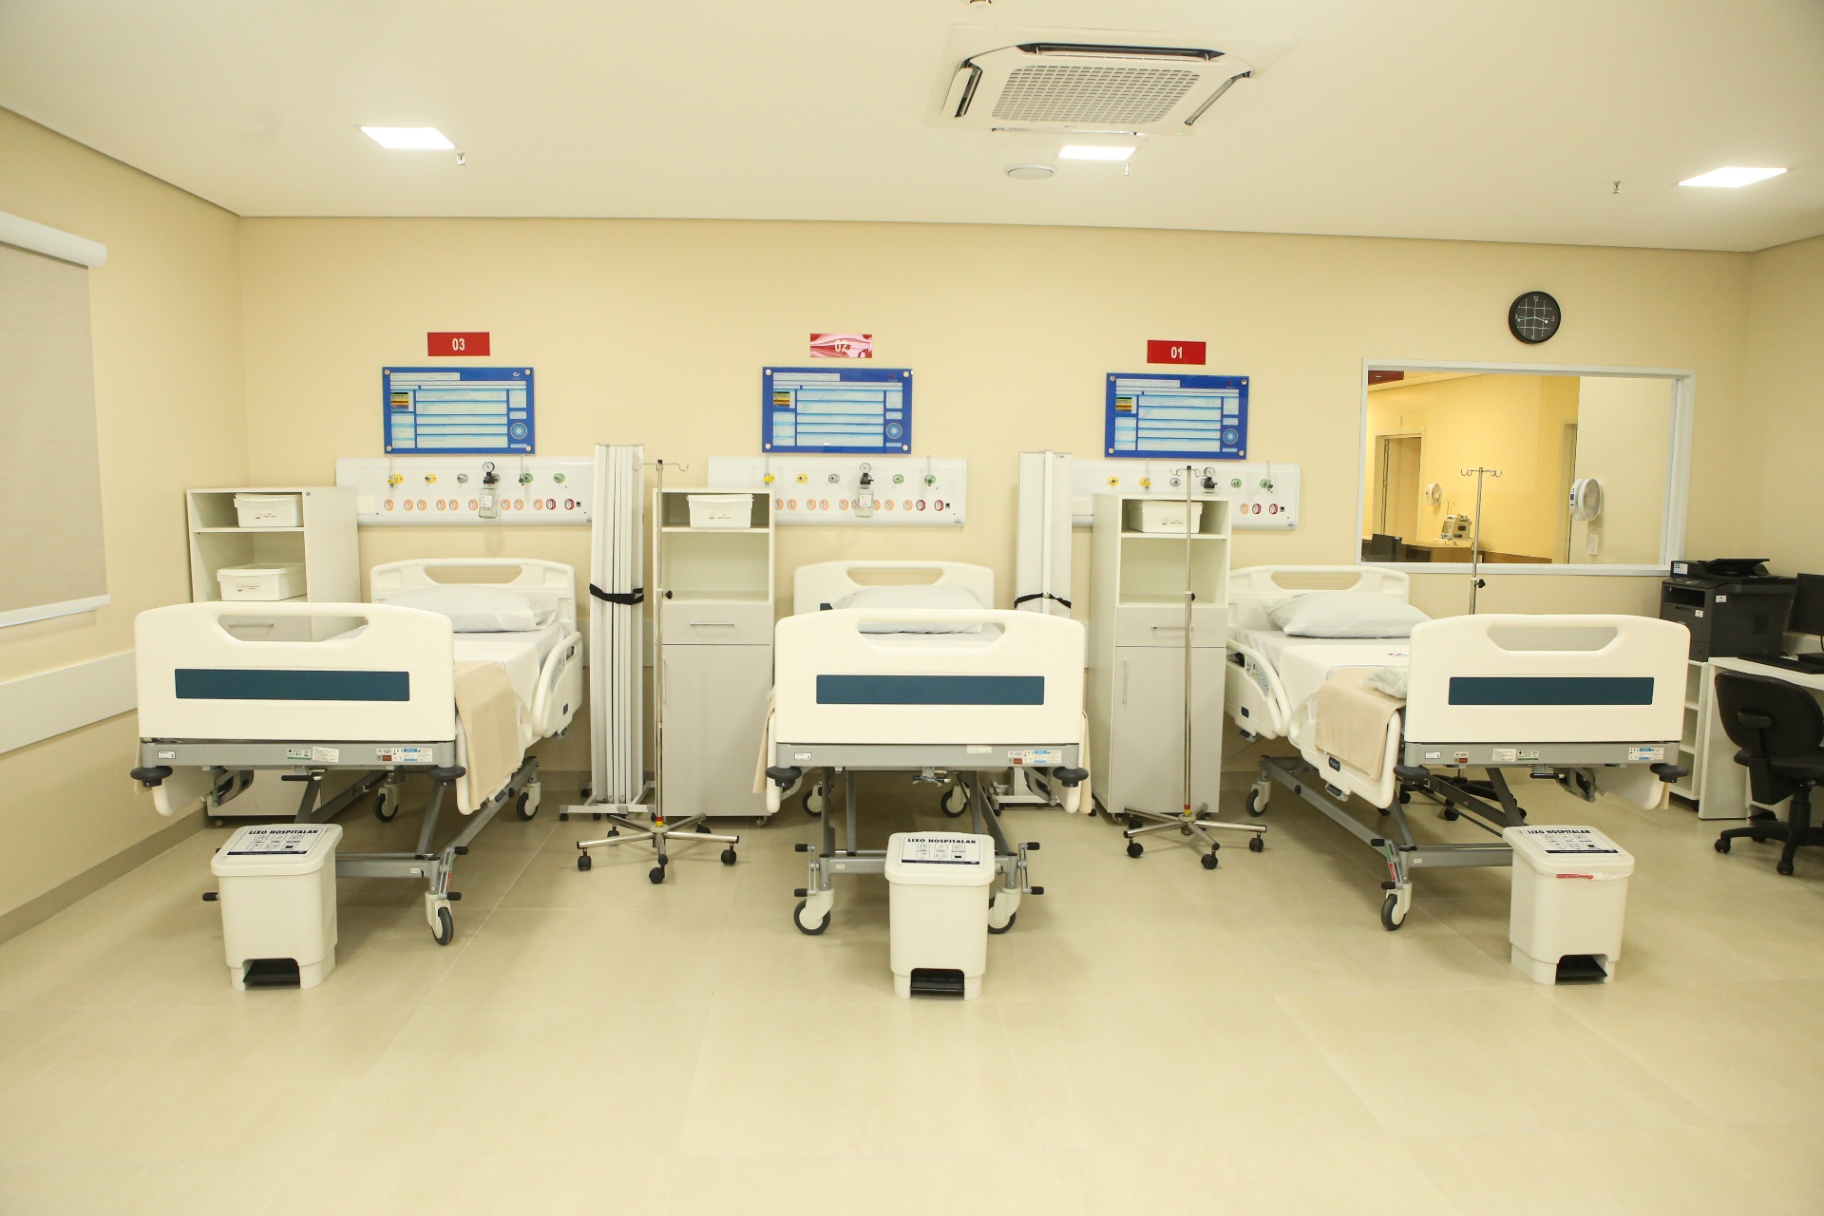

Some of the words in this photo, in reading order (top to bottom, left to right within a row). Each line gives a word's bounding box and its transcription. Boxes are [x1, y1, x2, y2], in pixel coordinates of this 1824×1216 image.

[452, 337, 466, 351] 03
[834, 339, 848, 352] 02
[1170, 346, 1183, 359] 01
